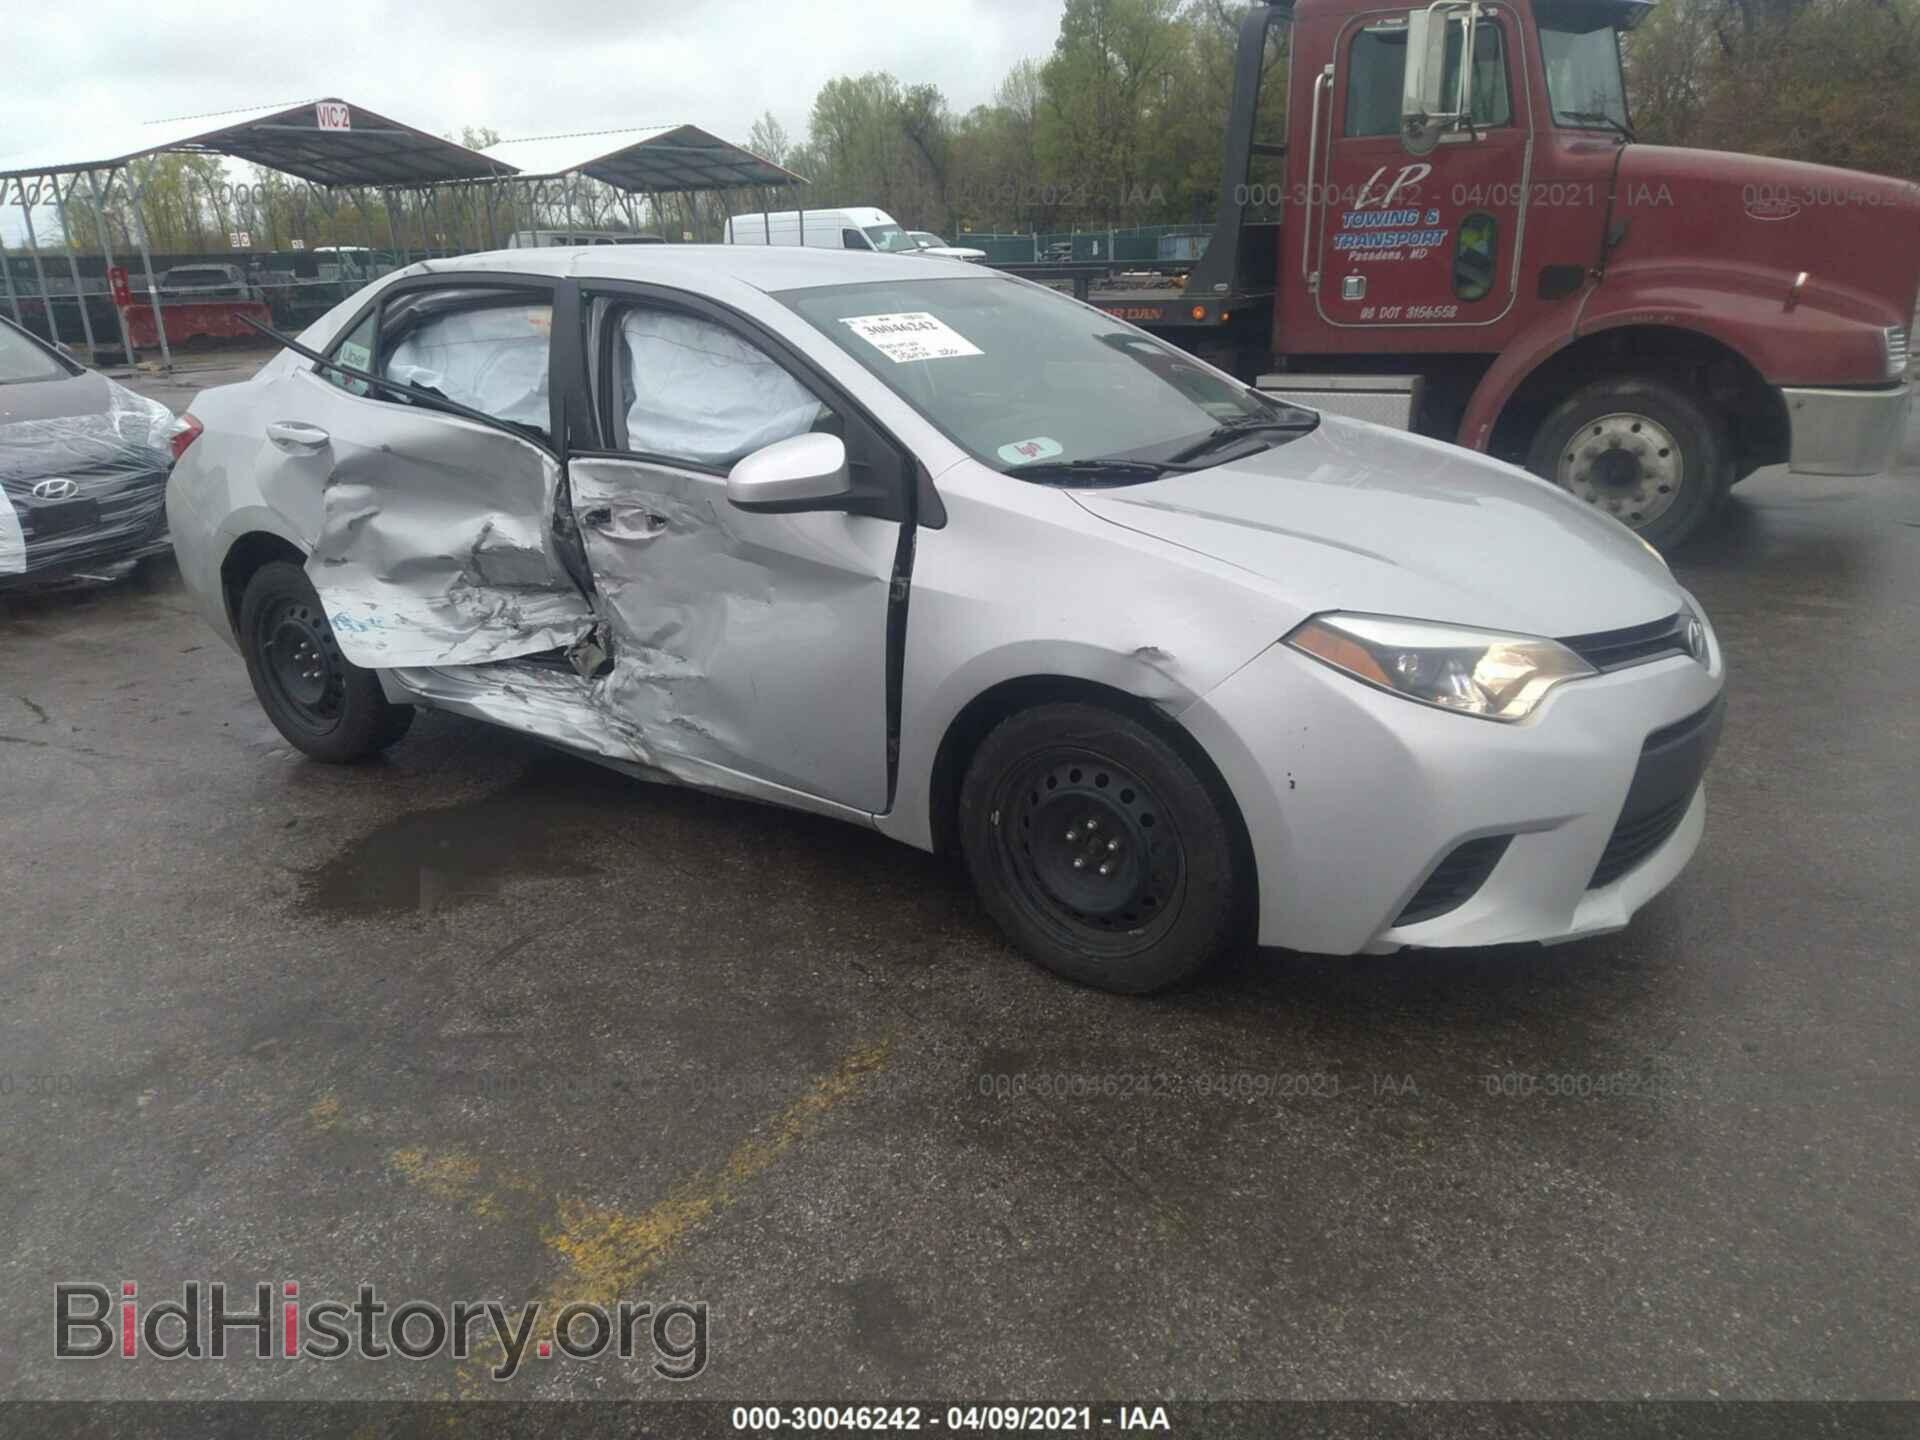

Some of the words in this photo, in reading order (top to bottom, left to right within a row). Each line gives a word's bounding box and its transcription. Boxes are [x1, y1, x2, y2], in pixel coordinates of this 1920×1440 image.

[1354, 163, 1432, 210] LP
[1343, 209, 1420, 228] TOWING
[1334, 229, 1448, 250] TRANSPORT
[1409, 247, 1428, 260] MD
[1379, 306, 1402, 319] DOT
